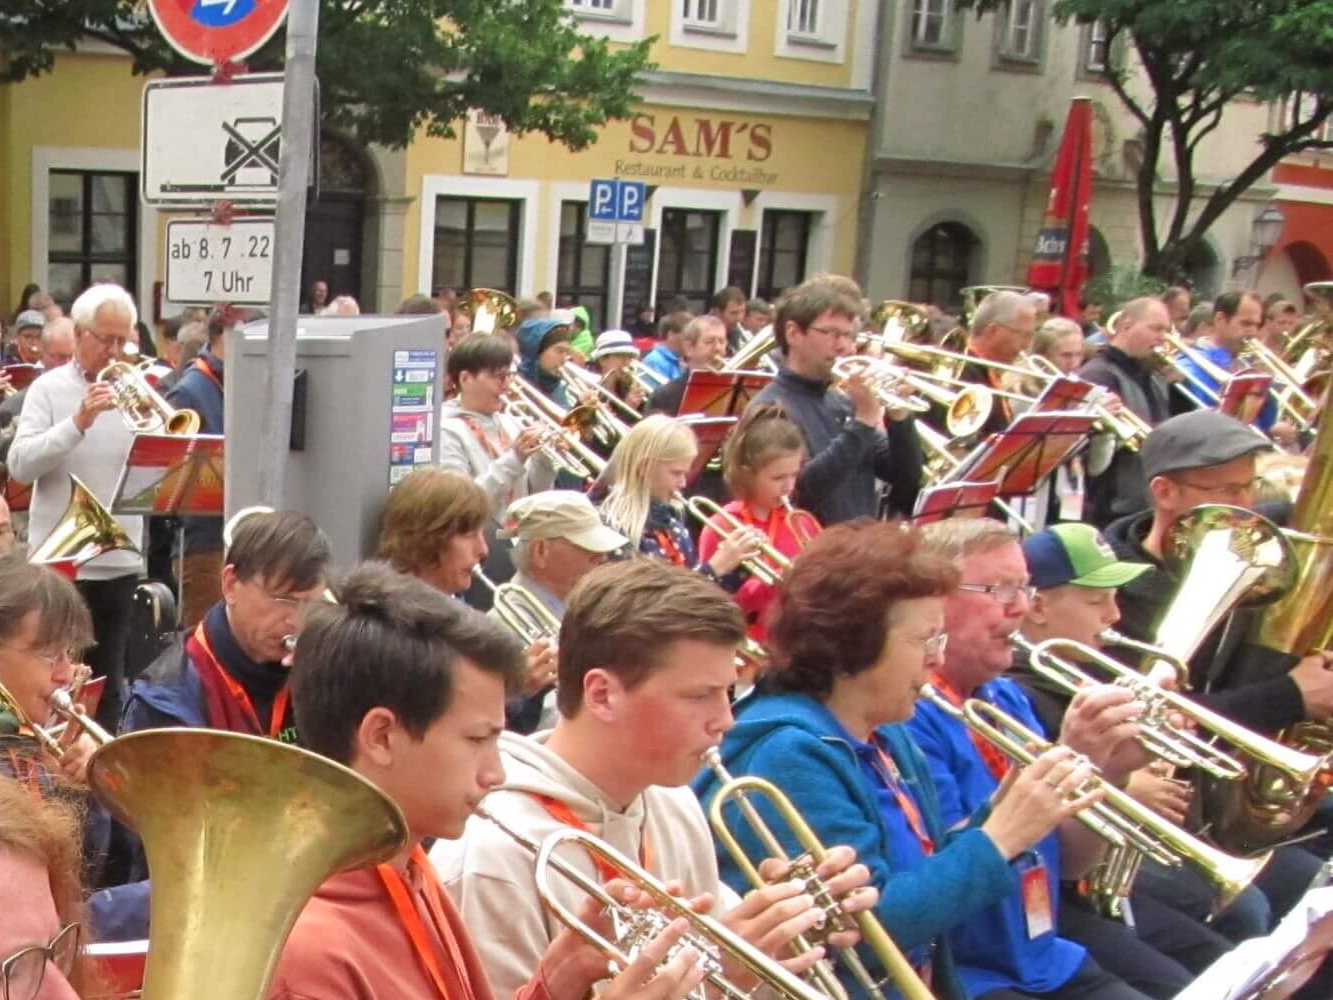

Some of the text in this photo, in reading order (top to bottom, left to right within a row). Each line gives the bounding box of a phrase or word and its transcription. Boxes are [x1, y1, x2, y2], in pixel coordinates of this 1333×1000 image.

[614, 159, 778, 184] Restaurant & Cocktailbar
[594, 183, 613, 215] P
[622, 185, 640, 216] P
[171, 238, 191, 259] ab
[204, 271, 254, 293] 7 Uhr
